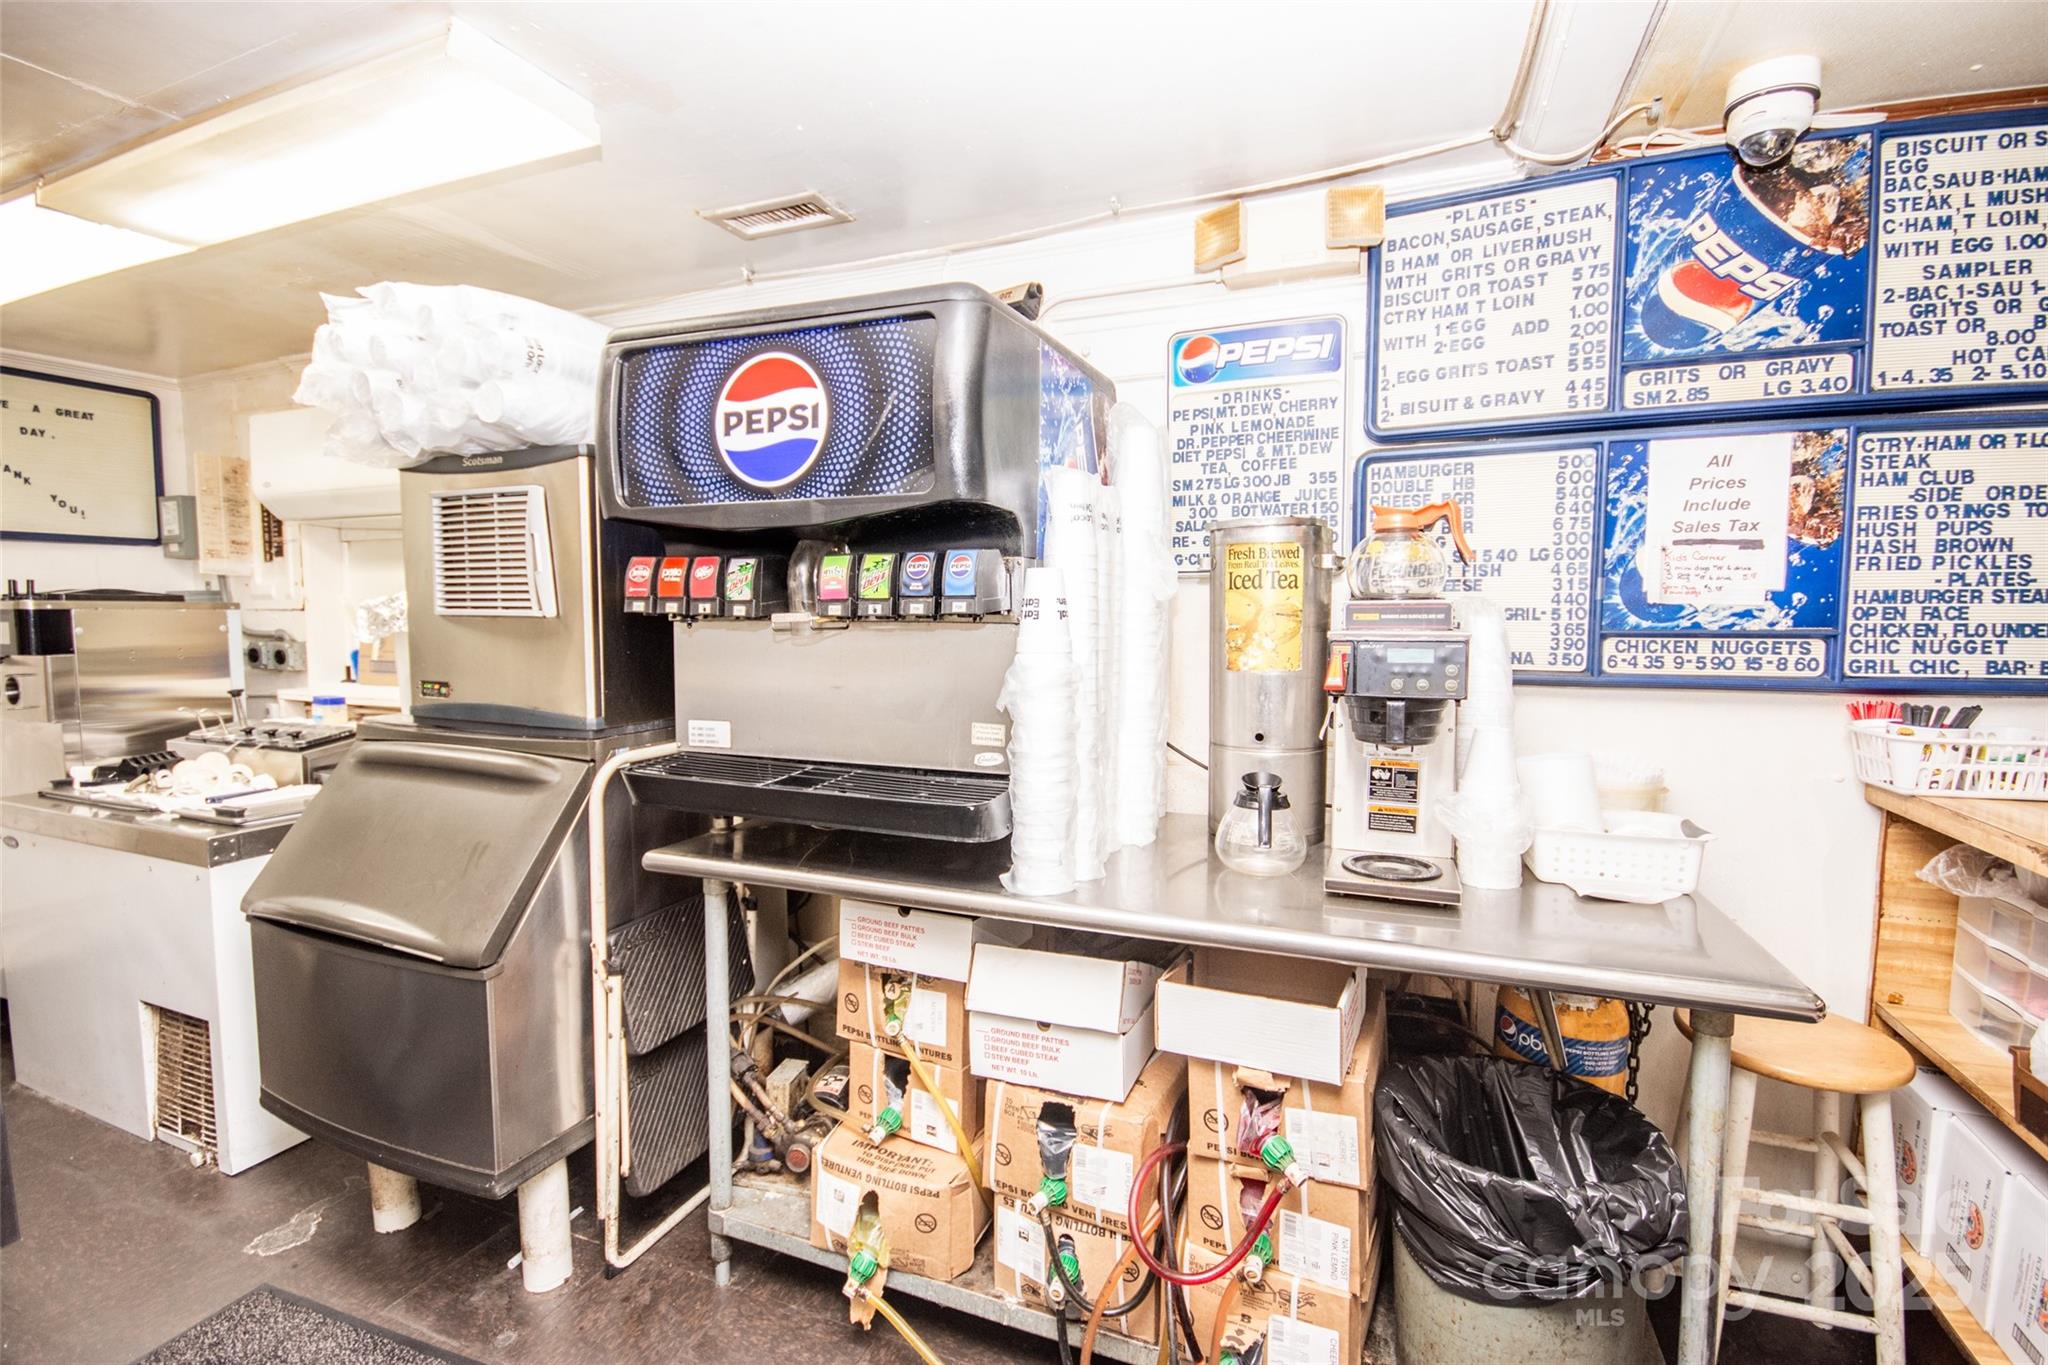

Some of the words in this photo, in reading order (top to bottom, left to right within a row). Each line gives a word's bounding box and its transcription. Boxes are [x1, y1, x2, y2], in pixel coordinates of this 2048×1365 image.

[1896, 135, 1987, 158] BISCUIT
[1998, 132, 2027, 149] OR
[1885, 158, 1928, 175] EGG
[1402, 254, 1439, 271] HAM
[1451, 248, 1472, 263] OR
[1483, 229, 1592, 258] LIVERMUSH
[1684, 212, 1800, 300] PEPSI
[1885, 240, 1938, 258] WITH
[1952, 237, 1993, 254] EGG
[1386, 274, 1427, 290] WITH
[1442, 262, 1495, 282] GRITS
[1504, 260, 1529, 274] OR
[1536, 246, 1601, 268] GRAVY
[1923, 259, 2033, 279] SAMPLER
[1384, 288, 1450, 307] BISCUIT
[1457, 283, 1480, 297] OR
[1488, 273, 1549, 293] TOAST
[1384, 307, 1426, 324] CTRY
[1432, 304, 1468, 319] HAM
[1476, 300, 1486, 313] T
[1493, 294, 1535, 311] LOIN
[1910, 301, 1978, 319] GRITS
[1994, 298, 2022, 314] OR
[1384, 335, 1426, 351] WITH
[1512, 319, 1549, 336] ADD
[1570, 302, 1609, 318] 1.00
[1880, 319, 1946, 338] TOAST
[1957, 318, 1985, 334] OR
[1986, 329, 2036, 346] 8.00
[1216, 334, 1334, 368] PEPSI
[1953, 348, 1996, 365] HOT
[1436, 362, 1488, 380] GRITS
[1496, 355, 1555, 373] TOAST
[1569, 340, 1606, 356] 505
[1568, 356, 1605, 372] 555
[1640, 368, 1700, 386] GRITS
[1719, 365, 1745, 379] OR
[1765, 357, 1834, 377] GRAVY
[1633, 391, 1661, 405] SM
[1666, 387, 1710, 403] 2.85
[1764, 381, 1792, 397] LG
[1800, 376, 1848, 393] 3.40
[1279, 397, 1338, 412] CHERRY
[1400, 398, 1458, 415] BISUIT
[1464, 396, 1474, 408] &
[1480, 390, 1544, 407] GRAVY
[32, 405, 40, 413] A
[56, 408, 94, 421] GREAT
[723, 402, 819, 437] PEPSI
[1191, 422, 1224, 436] PINK
[1231, 416, 1315, 433] LEMONADE
[1257, 428, 1339, 445] CHEERWINE
[1979, 434, 2006, 449] OR
[1173, 450, 1201, 463] DIET
[1206, 448, 1246, 462] PEPSI
[1257, 446, 1265, 457] &
[1300, 441, 1333, 455] DEW
[462, 455, 503, 467] Scotsman
[1241, 458, 1297, 472] COFFEE
[1707, 454, 1733, 468] All
[1861, 453, 1931, 470] STEAK
[1371, 463, 1474, 480] HAMBURGER
[1861, 472, 1908, 486] HAM
[1920, 470, 1974, 486] CLUB
[1173, 479, 1194, 491] SM
[1309, 472, 1337, 484] 355
[1372, 479, 1433, 494] DOUBLE
[1453, 477, 1474, 490] HB
[1689, 478, 1747, 490] Prices
[1173, 495, 1204, 506] MILK
[1208, 493, 1216, 505] &
[1221, 490, 1281, 504] ORANGE
[1295, 487, 1337, 502] JUICE
[1370, 494, 1431, 507] CHEESE
[51, 495, 86, 519] YOU!
[1189, 507, 1218, 519] 300
[1683, 499, 1751, 512] Include
[1858, 504, 1917, 521] FRIES
[1672, 520, 1720, 534] Sales
[1729, 520, 1760, 532] Tax
[1856, 523, 1916, 537] HUSH
[1936, 521, 1992, 536] PUPS
[1228, 547, 1255, 561] Fresh
[1856, 540, 1916, 554] HASH
[1935, 538, 2013, 554] BROWN
[1530, 549, 1550, 561] LG
[1855, 556, 1921, 571] FRIED
[1932, 554, 2032, 570] PICKLES
[1243, 560, 1260, 569] Real
[1463, 564, 1501, 577] FISH
[1229, 571, 1262, 591] Iced
[1266, 570, 1299, 589] Tea
[1854, 589, 1983, 604] HAMBURGER
[1853, 606, 1906, 621] OPEN
[1921, 606, 1969, 620] FACE
[1615, 640, 1698, 654] CHICKEN
[1712, 640, 1811, 656] NUGGETS
[1850, 640, 1900, 654] CHIC
[1912, 640, 2008, 655] NUGGET
[1849, 660, 1900, 674] GRIL
[858, 916, 882, 926] GROUND
[901, 924, 925, 934] PATTIES
[858, 924, 882, 934] GROUND
[901, 932, 917, 940] BULK
[858, 932, 872, 940] BEEF
[874, 936, 894, 945] CUBED
[896, 940, 916, 948] STEAK
[858, 940, 873, 948] STEW
[842, 1024, 863, 1036] PEPSI
[991, 1028, 1020, 1038] GROUND
[1022, 1032, 1040, 1040] BEEF
[1042, 1035, 1069, 1046] PATTIES
[991, 1036, 1020, 1046] GROUND
[1022, 1041, 1040, 1049] BEEF
[1042, 1045, 1061, 1053] BULK
[991, 1045, 1008, 1053] BEEF
[1010, 1048, 1034, 1058] CUBED
[1036, 1052, 1059, 1062] STEAK
[992, 1053, 1010, 1061] STEW
[856, 1157, 874, 1166] THIS
[877, 1163, 896, 1173] SIDE
[874, 1155, 916, 1170] DISPENSE
[866, 1173, 907, 1192] BOTTLING
[910, 1187, 940, 1198] PEPSI
[1055, 1215, 1106, 1238] BOTTLING
